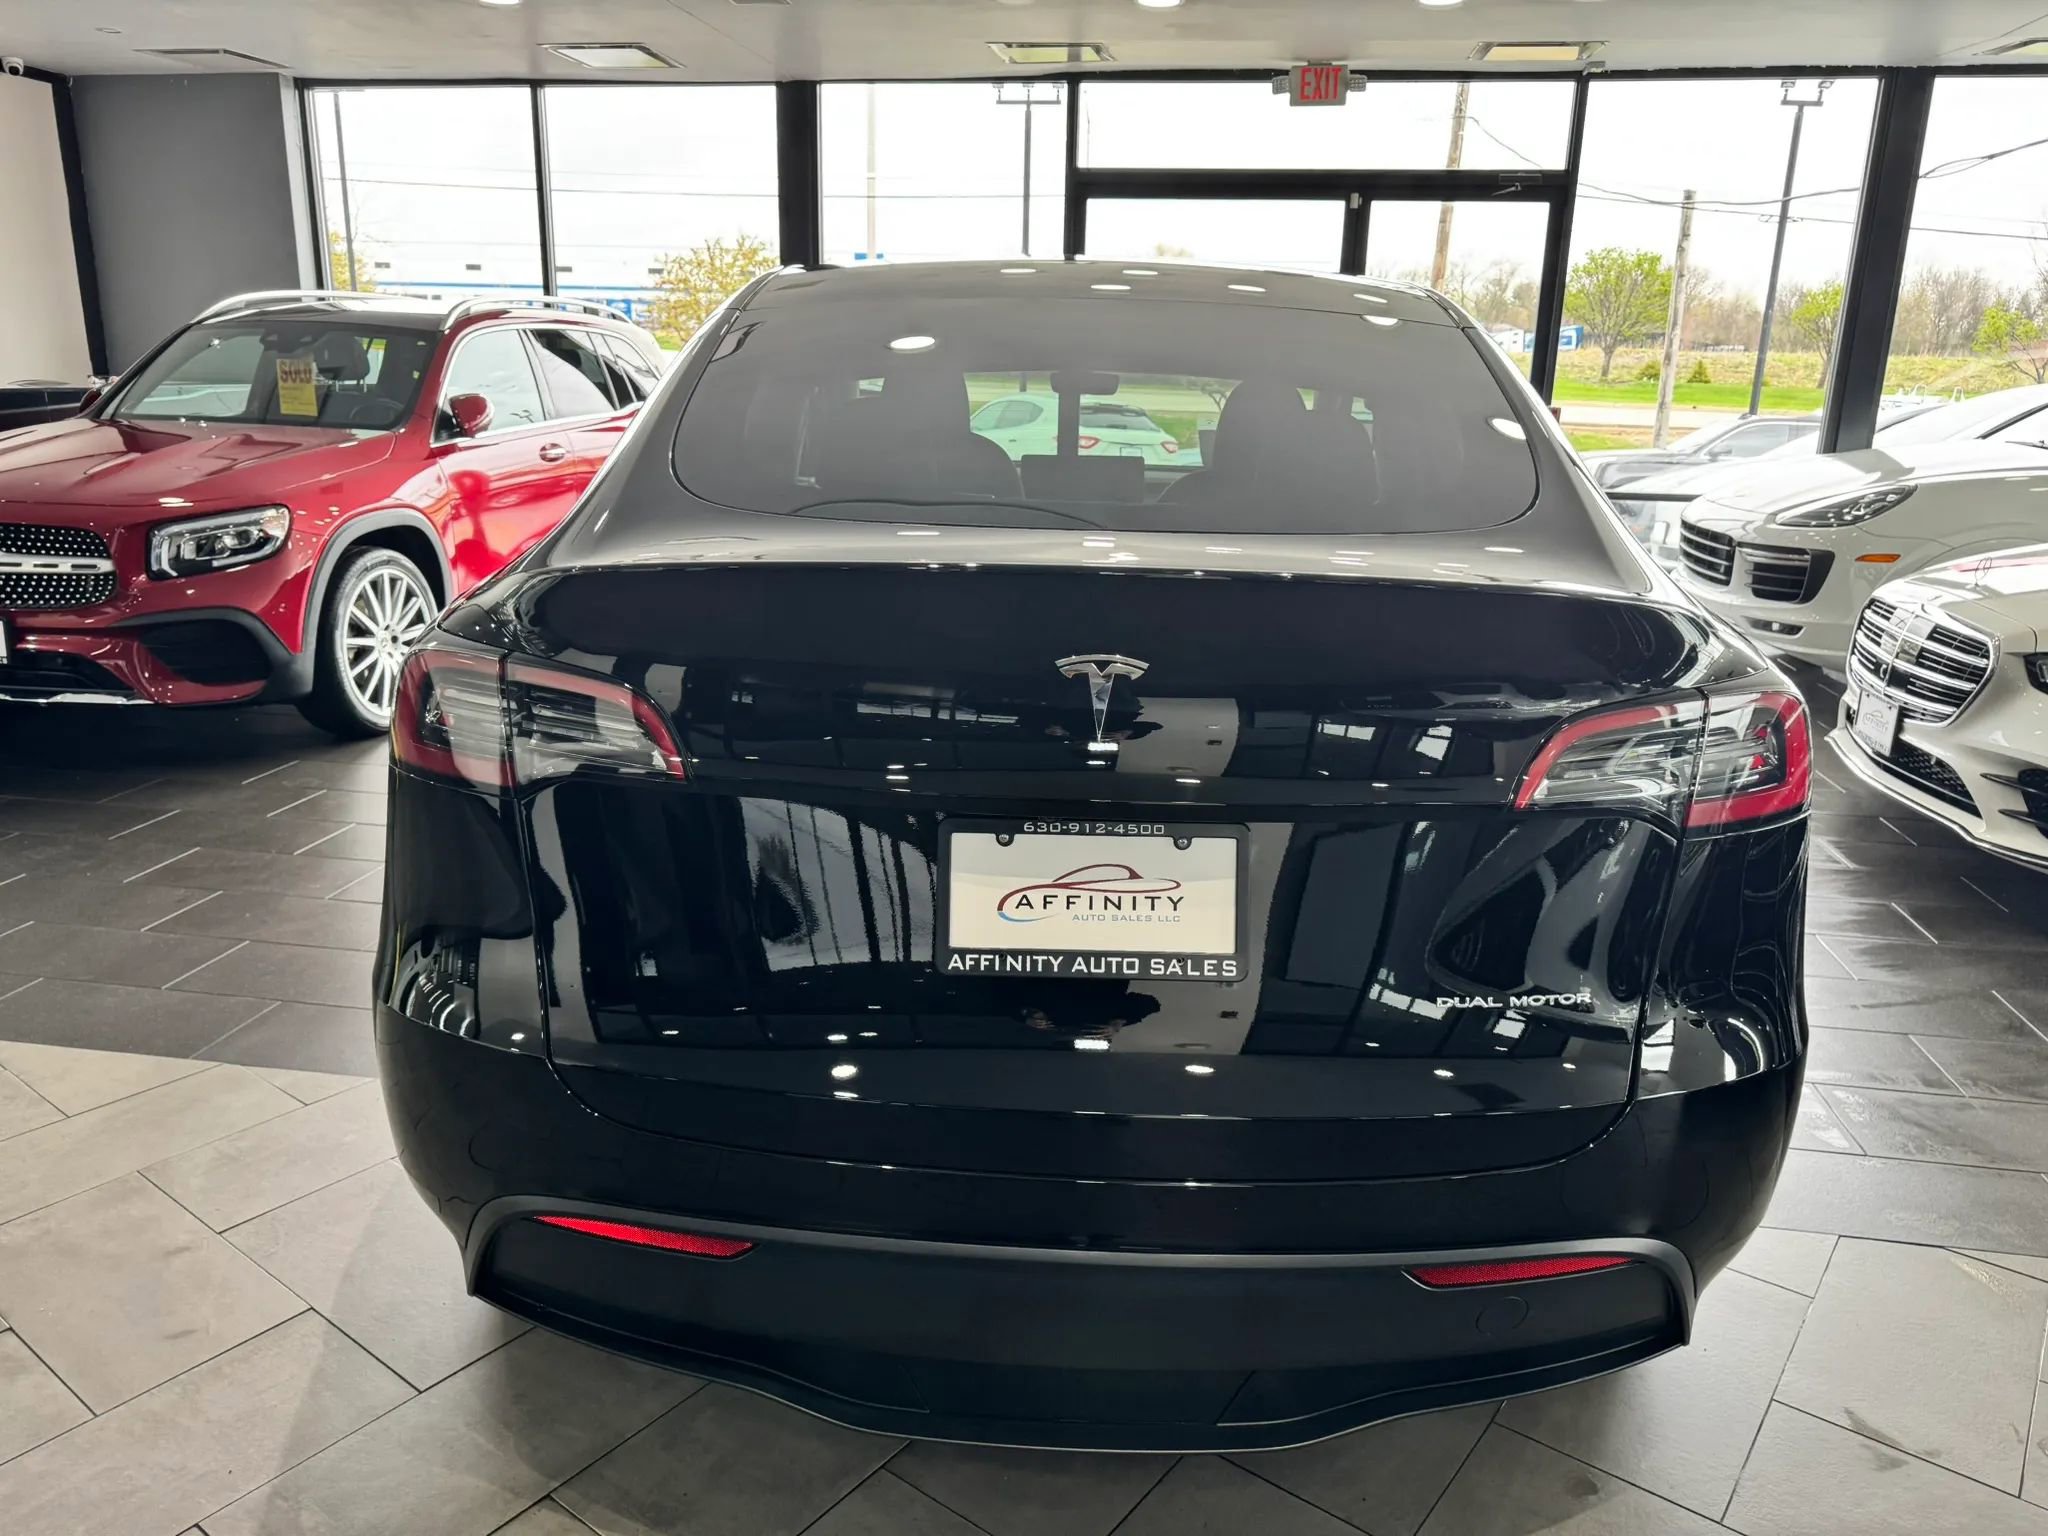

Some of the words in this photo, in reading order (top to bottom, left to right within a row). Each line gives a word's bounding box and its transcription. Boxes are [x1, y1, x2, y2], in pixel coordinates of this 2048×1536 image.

[1301, 67, 1342, 100] EXIT
[1023, 821, 1165, 835] 630-912-4500
[1015, 894, 1184, 911] AFFINITY
[1072, 913, 1106, 922] AUTO
[1111, 914, 1152, 922] SALES
[1157, 914, 1180, 922] LLC
[948, 953, 1062, 973] AFFINITY
[1071, 957, 1139, 974] AUTO
[1150, 957, 1237, 976] SALES
[1436, 996, 1503, 1008] DUAL
[1509, 993, 1592, 1007] MOTOR
